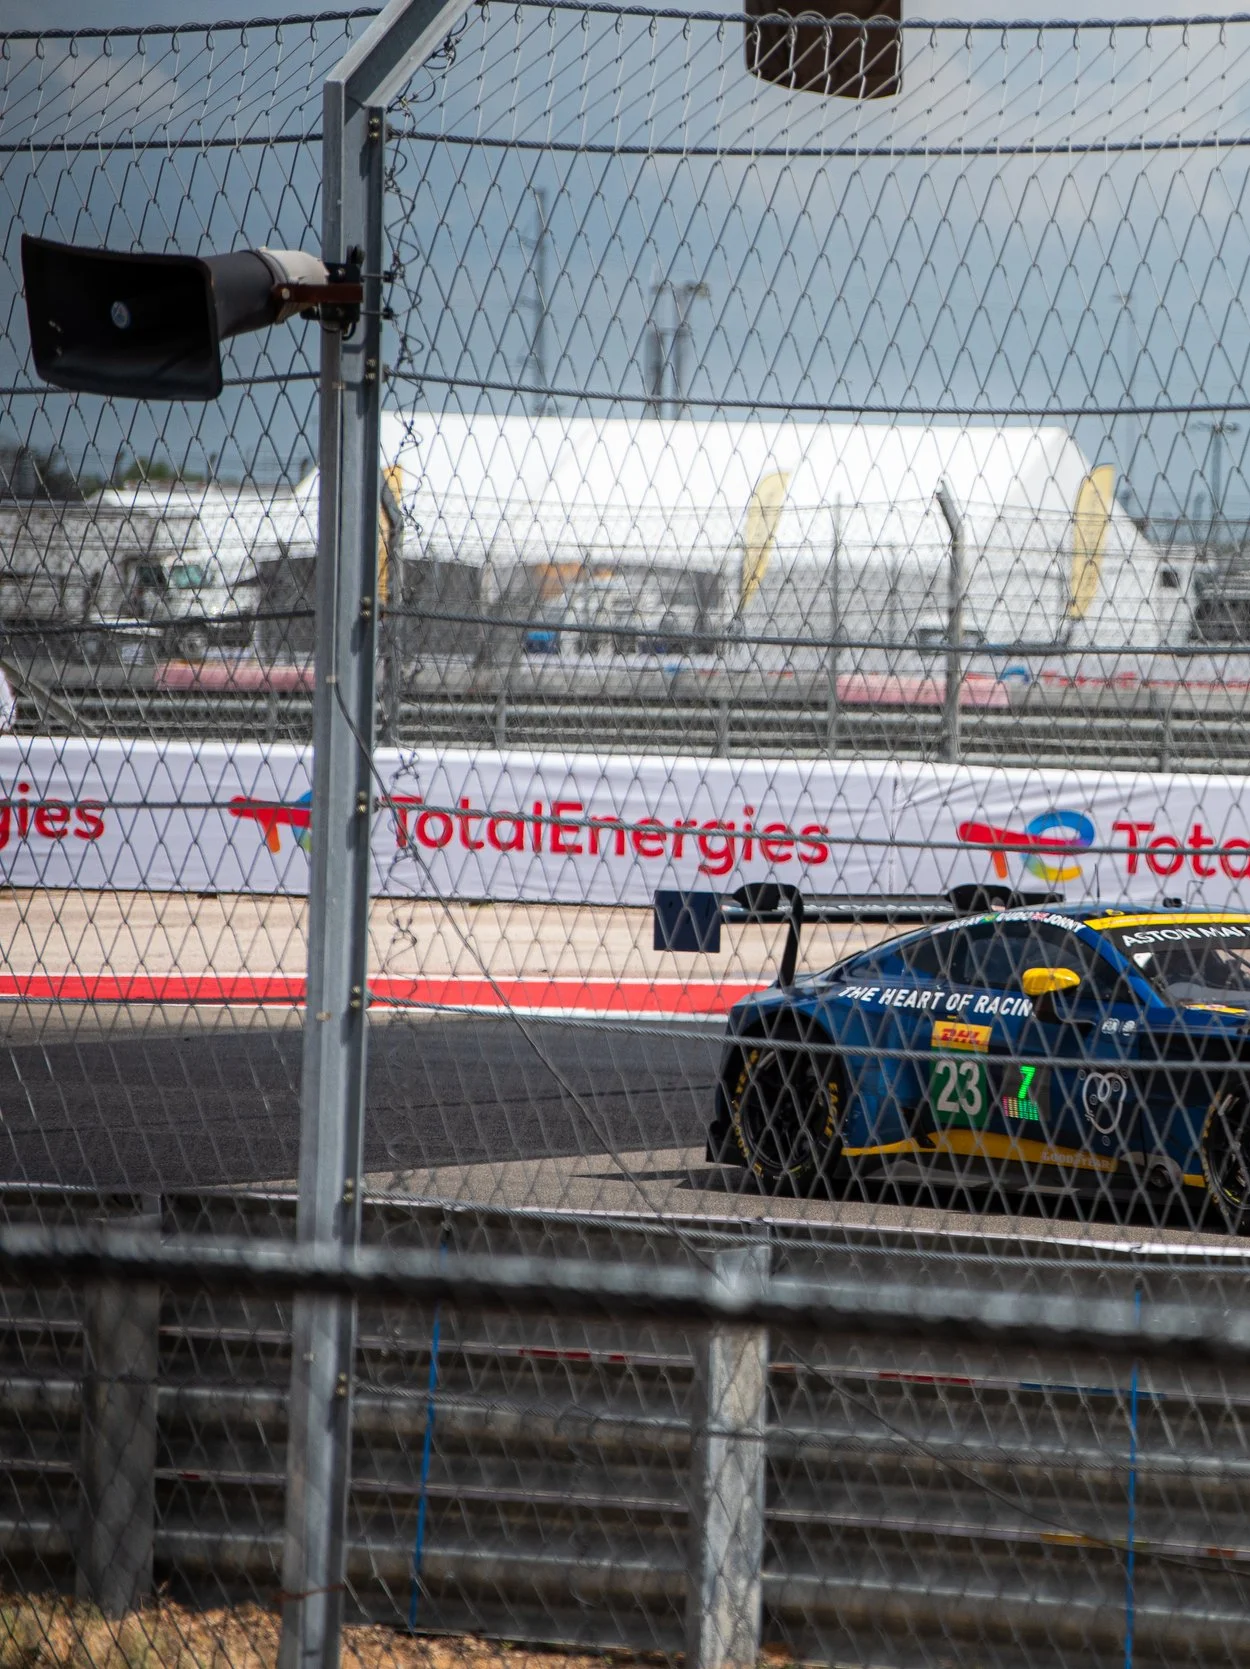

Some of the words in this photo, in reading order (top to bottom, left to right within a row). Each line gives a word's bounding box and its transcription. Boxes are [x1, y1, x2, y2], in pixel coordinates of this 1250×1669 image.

[383, 795, 830, 876] TotalEnergies
[1044, 913, 1087, 933] JONNY
[1121, 927, 1200, 947] ASTON
[838, 986, 881, 1001] THE
[878, 988, 945, 1010] HEART
[946, 993, 971, 1012] OF
[973, 995, 1038, 1018] RACIN
[941, 1027, 982, 1045] DHL
[936, 1060, 982, 1116] 23
[1017, 1065, 1036, 1099] 7
